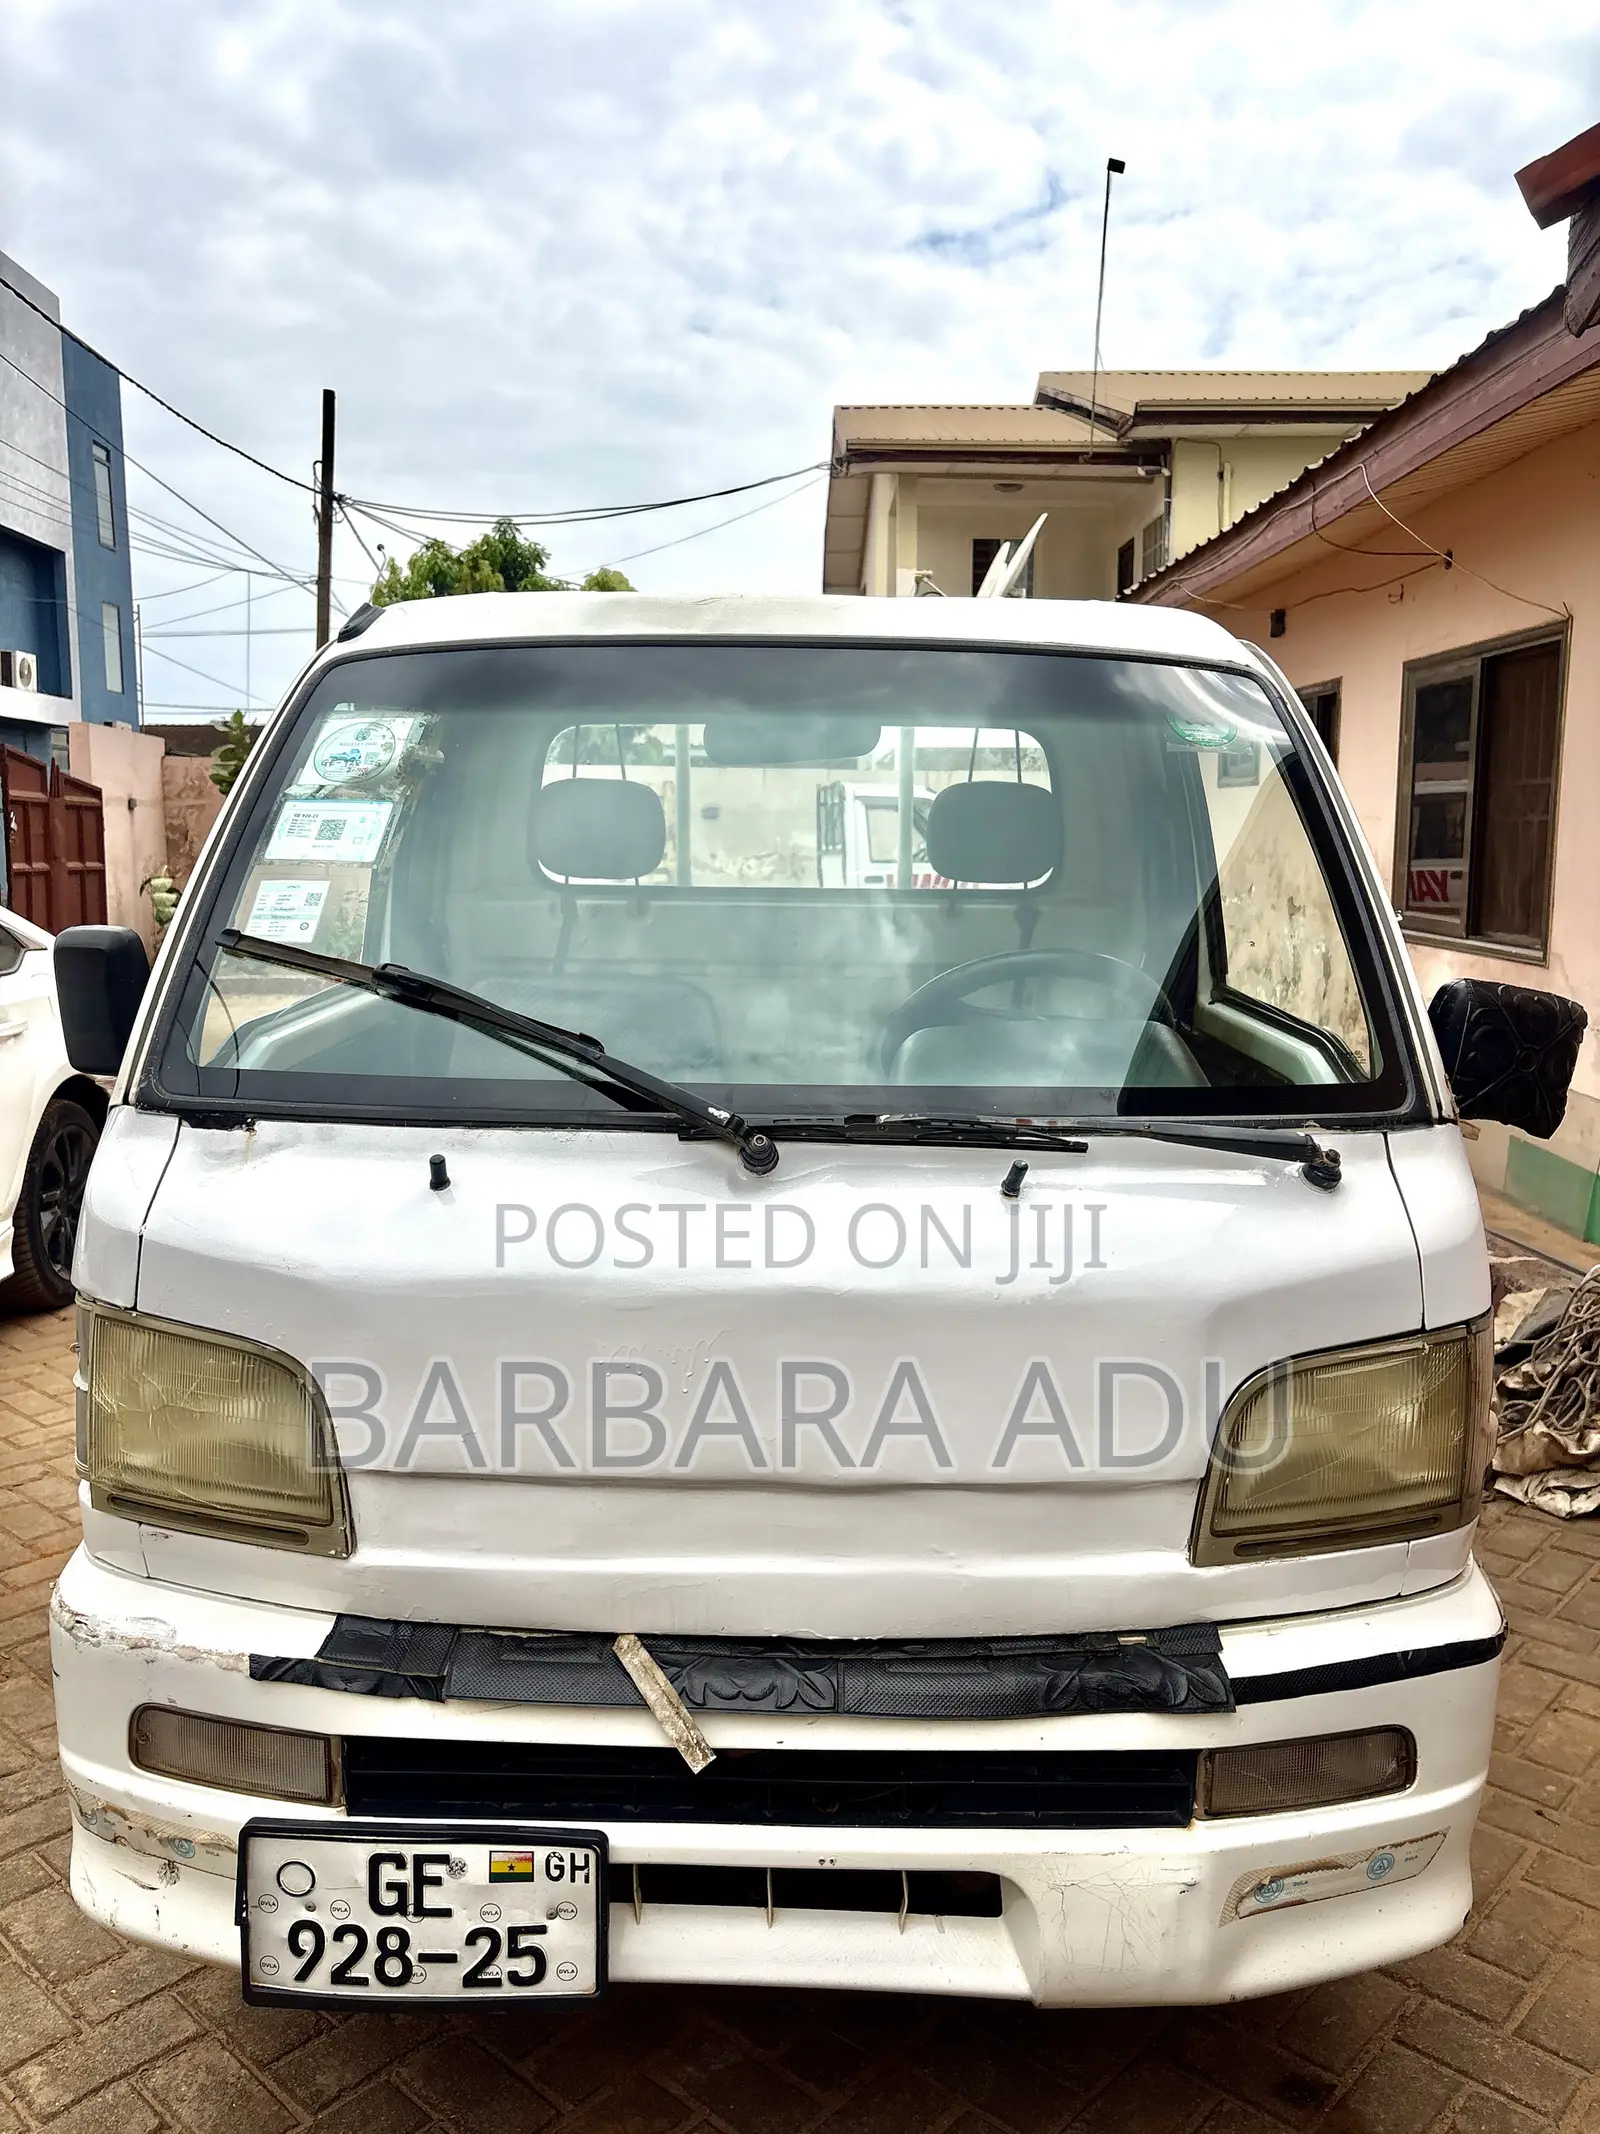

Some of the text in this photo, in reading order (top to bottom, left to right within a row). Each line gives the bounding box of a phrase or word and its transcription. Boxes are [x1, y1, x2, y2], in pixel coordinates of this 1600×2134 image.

[368, 1851, 454, 1918] GE
[544, 1851, 590, 1885] GH
[260, 1900, 277, 1908] DVLA
[287, 1919, 549, 1987] 928-25
